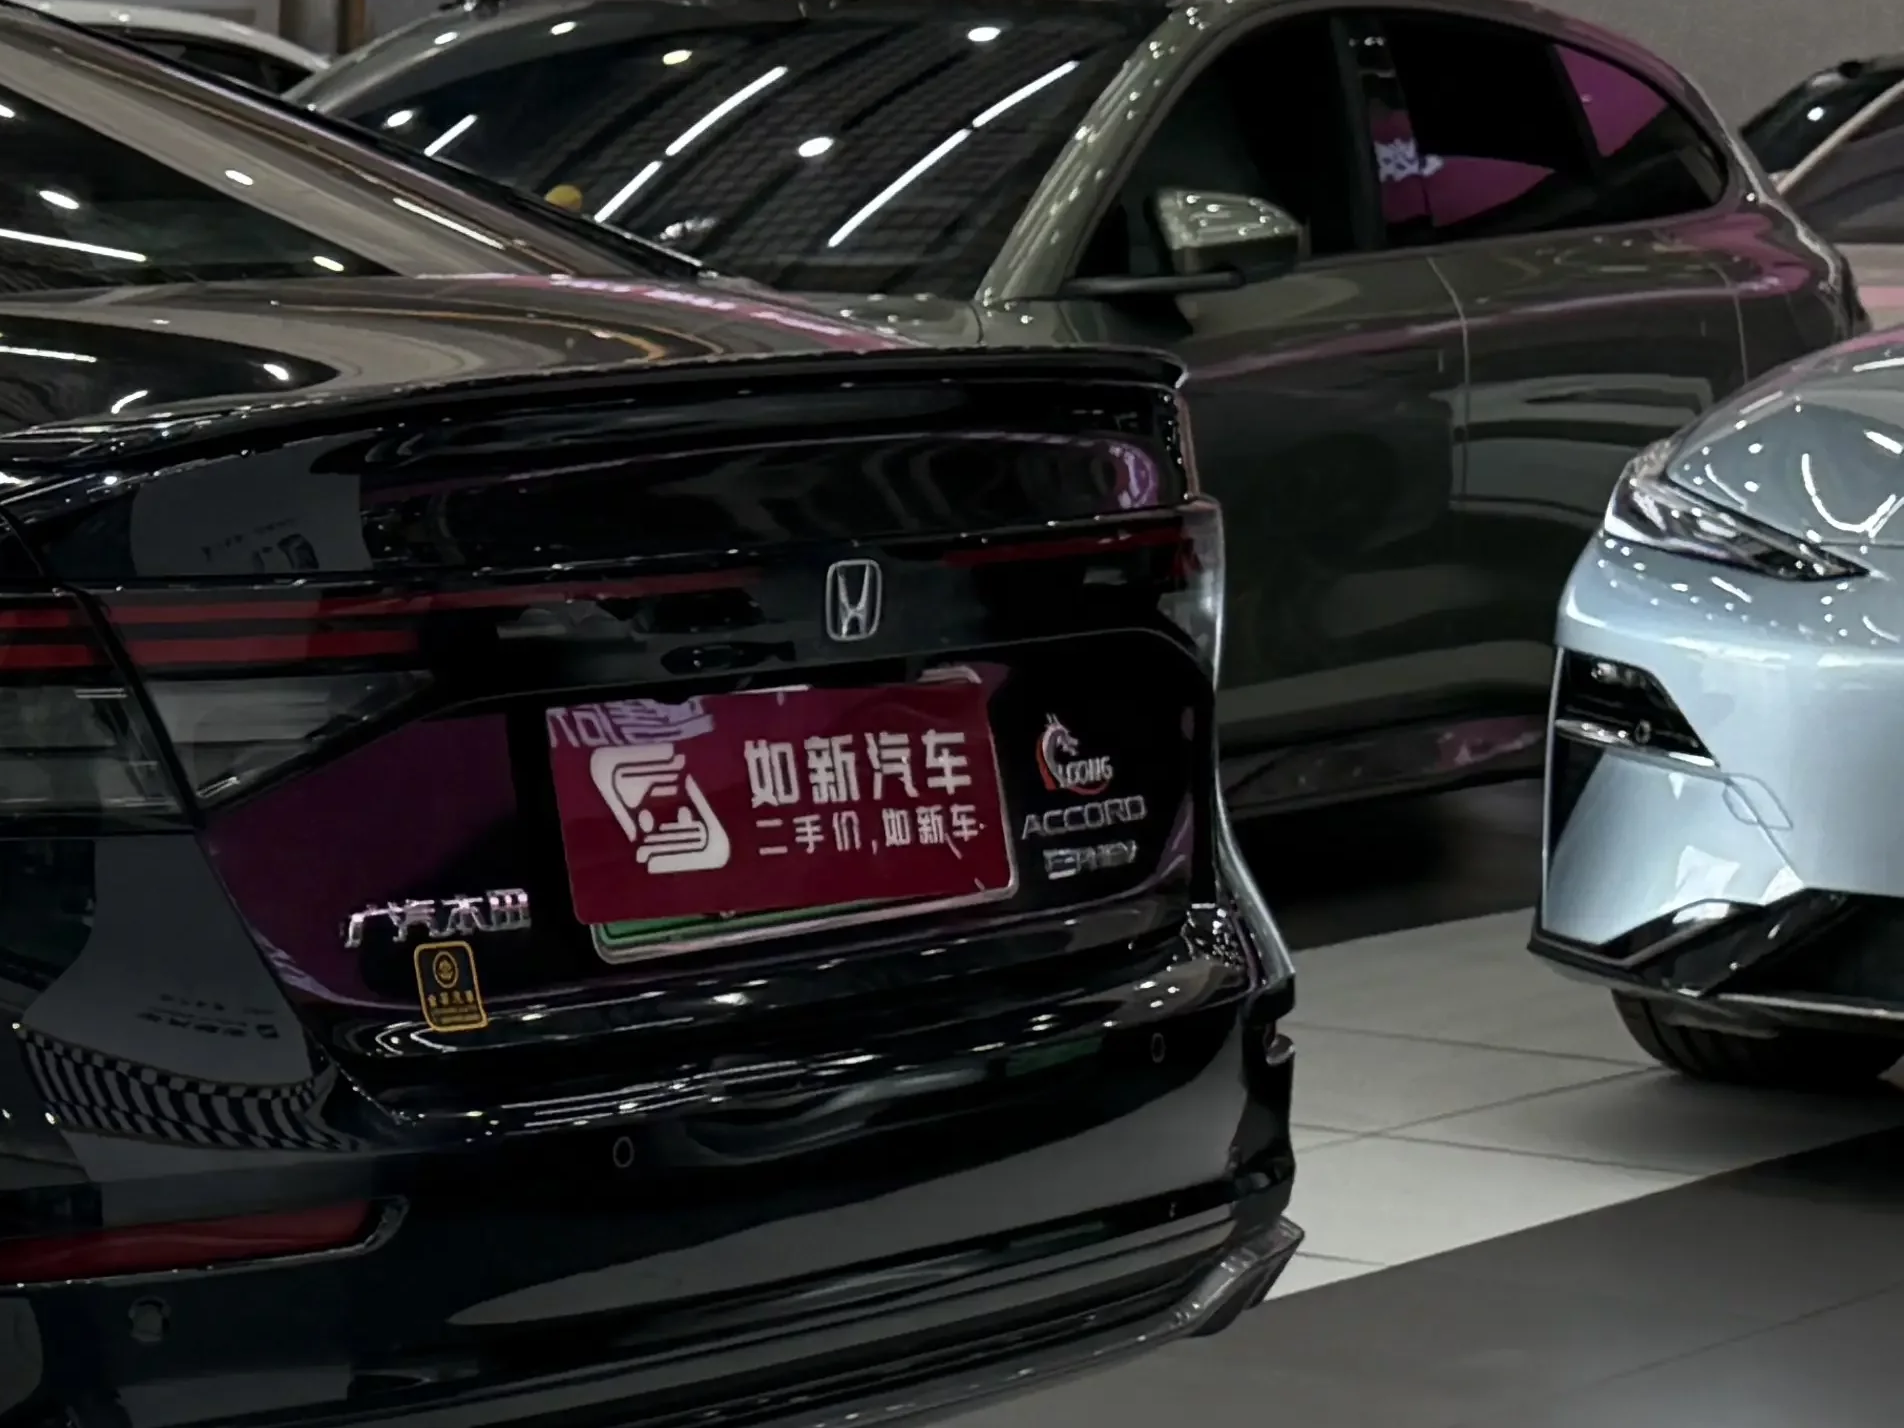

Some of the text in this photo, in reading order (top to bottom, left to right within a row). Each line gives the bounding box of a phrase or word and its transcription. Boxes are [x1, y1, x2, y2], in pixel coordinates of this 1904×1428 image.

[744, 729, 972, 809] 如新汽车
[1021, 795, 1148, 840] ACCORD
